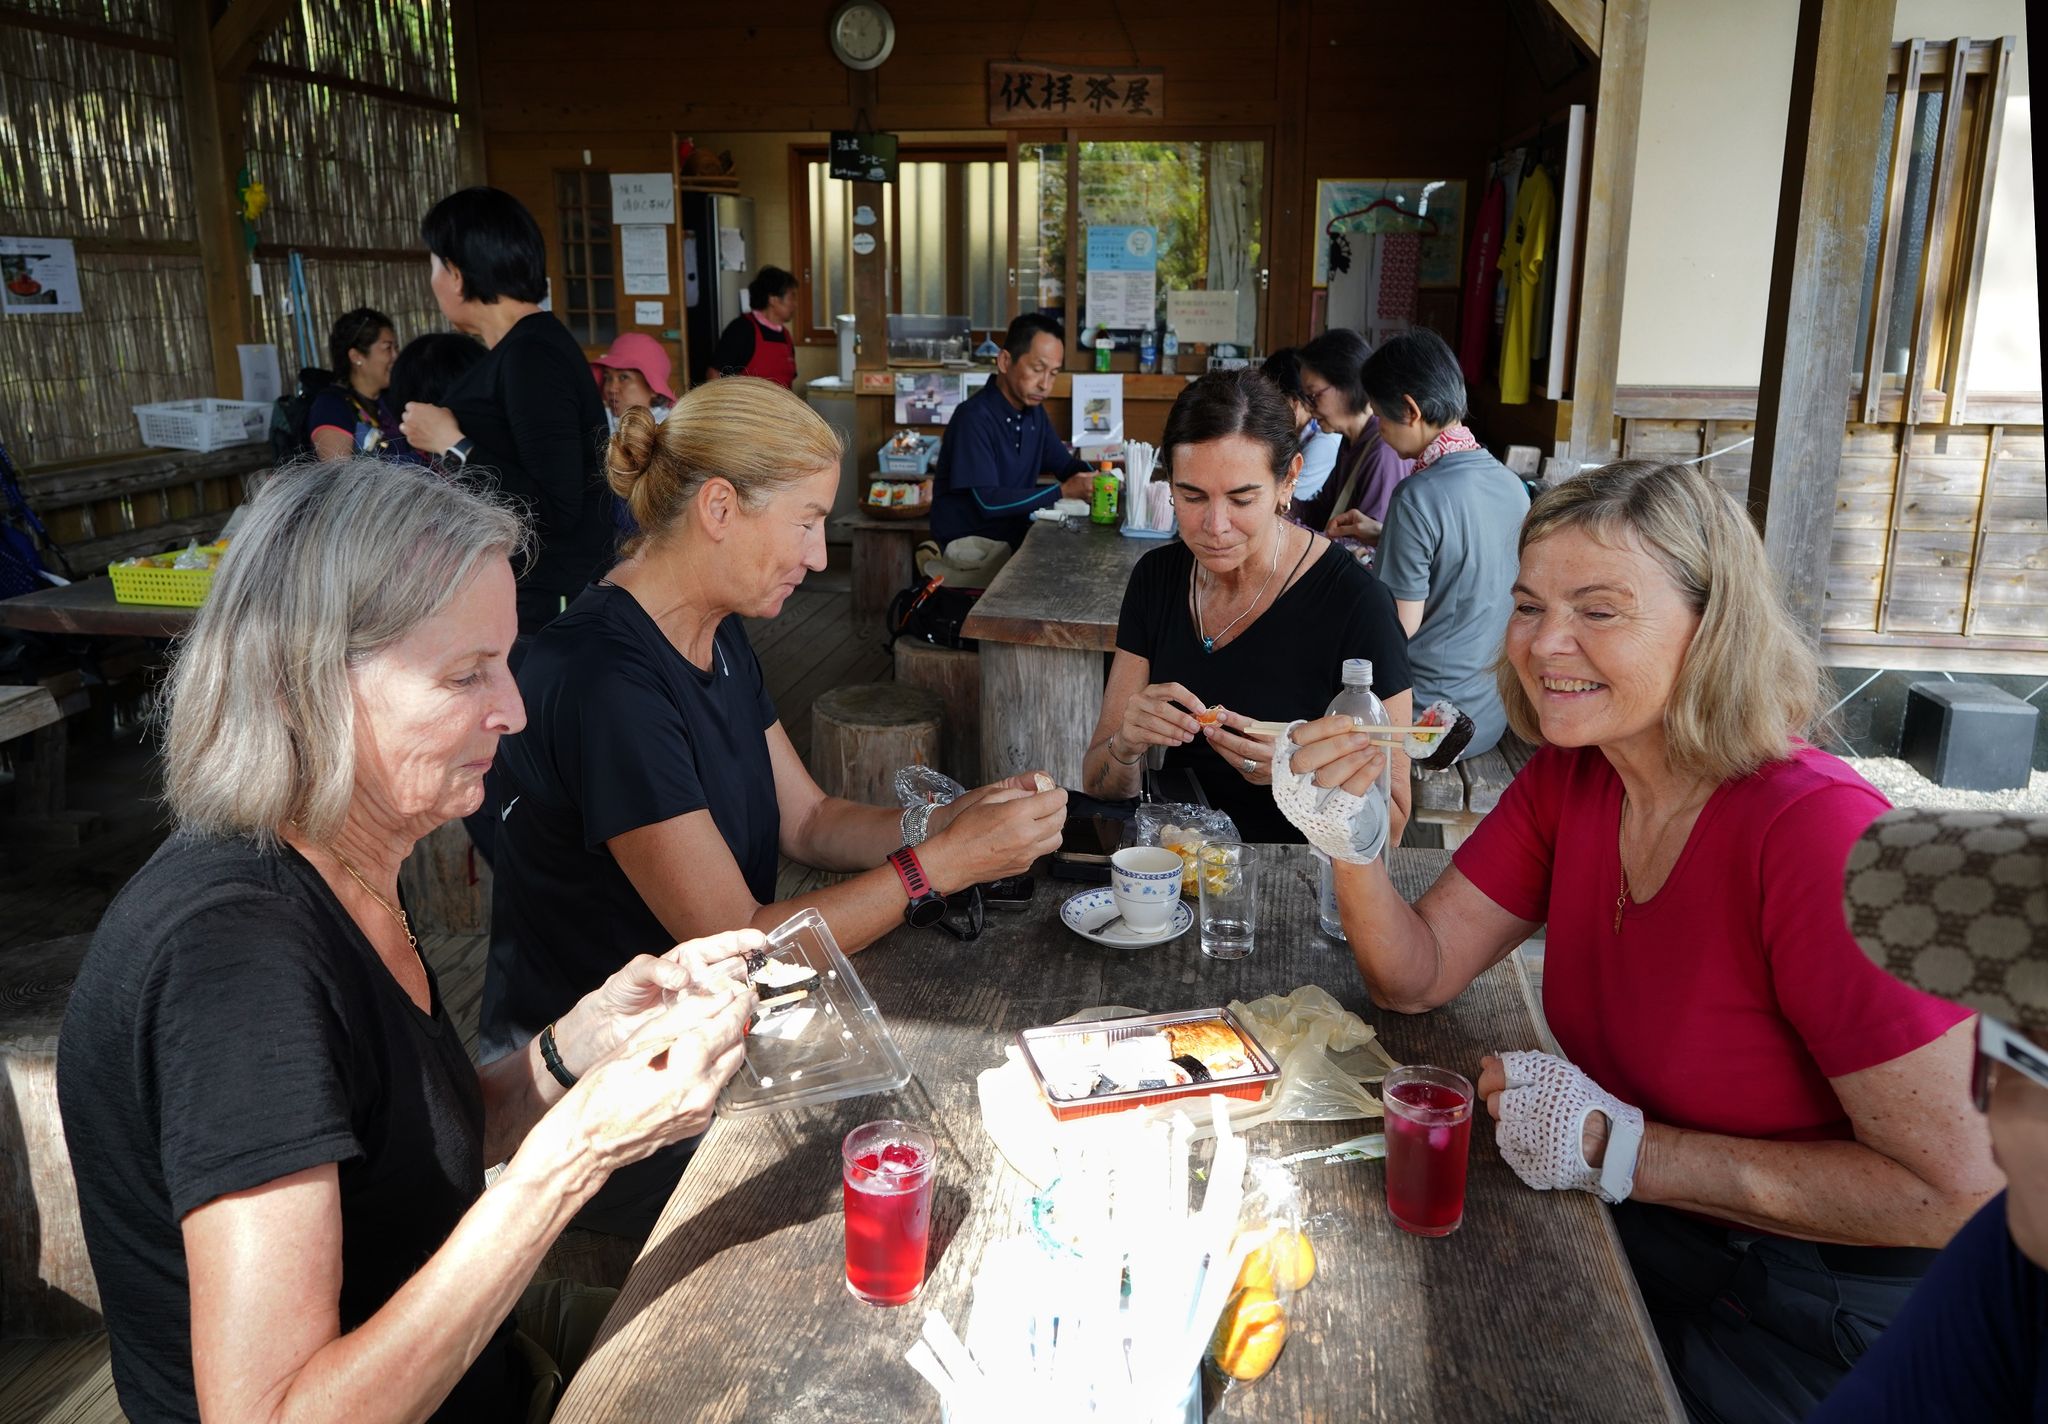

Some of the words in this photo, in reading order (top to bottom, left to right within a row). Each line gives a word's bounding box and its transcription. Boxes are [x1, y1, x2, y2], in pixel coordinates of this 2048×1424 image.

[1000, 73, 1154, 116] 伏拝茶屋
[859, 154, 888, 166] コーヒー
